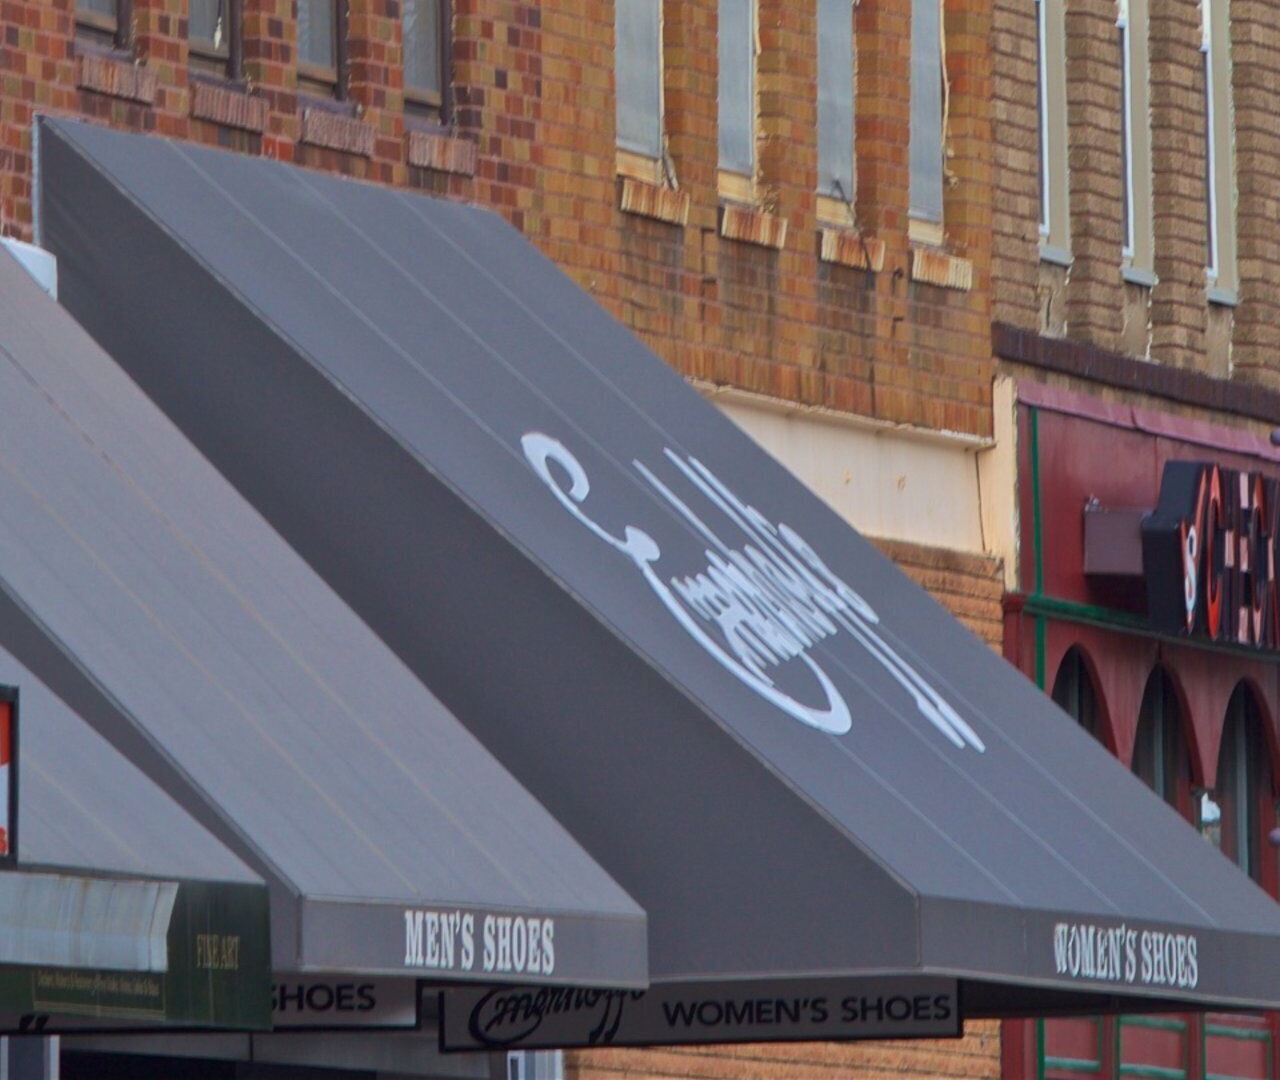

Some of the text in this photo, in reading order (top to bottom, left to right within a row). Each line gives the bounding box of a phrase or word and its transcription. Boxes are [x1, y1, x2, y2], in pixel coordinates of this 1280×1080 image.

[196, 933, 240, 971] FINE ART
[404, 910, 555, 976] MEN'S SHOES
[1053, 922, 1198, 989] WOMEN'S SHOES
[661, 995, 828, 1030] WOMEN'S
[841, 993, 952, 1024] SHOES
